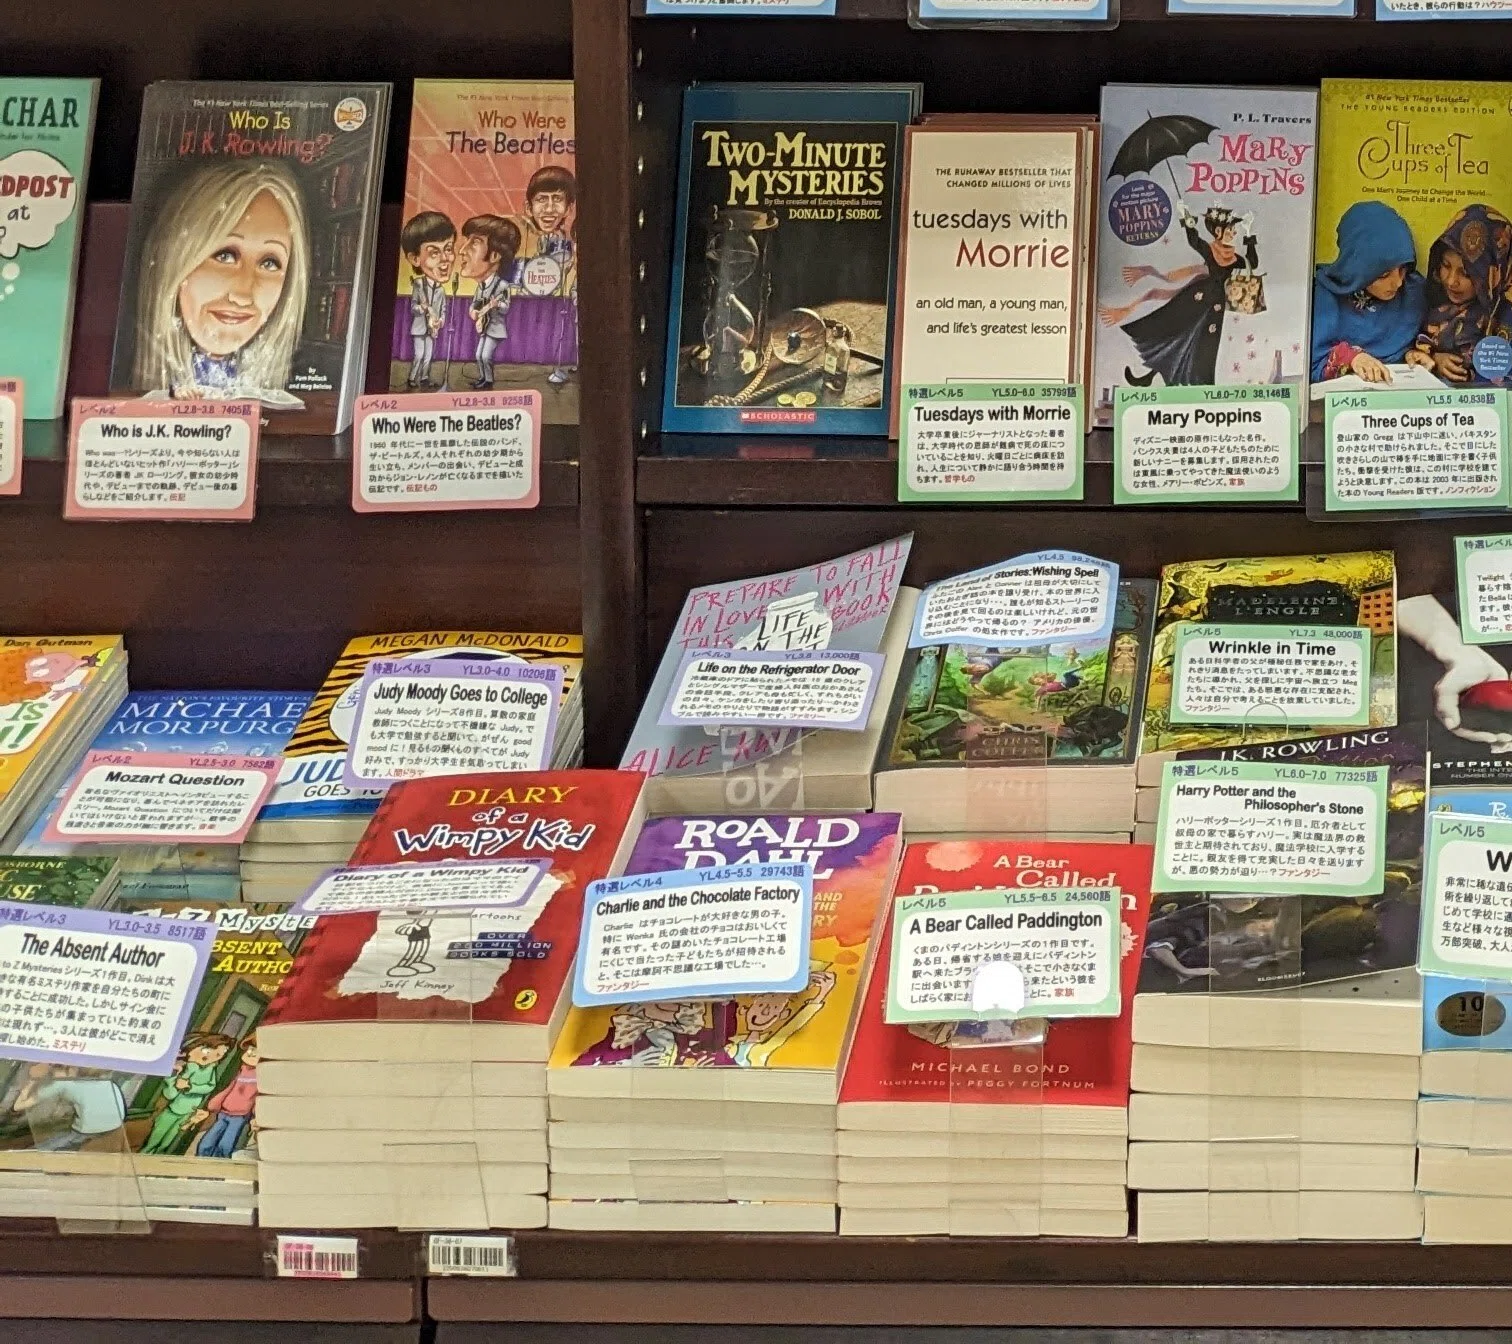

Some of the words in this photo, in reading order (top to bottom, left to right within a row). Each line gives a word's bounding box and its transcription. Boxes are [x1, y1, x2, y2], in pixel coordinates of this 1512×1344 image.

[913, 208, 1011, 232] tuesdays
[1019, 207, 1068, 230] with
[956, 238, 1070, 269] Morrie
[372, 416, 400, 434] Who
[403, 416, 436, 433] Were
[440, 415, 464, 432] The
[466, 413, 522, 431] Beatles?
[749, 412, 816, 422] SCHOLASTIC
[374, 682, 402, 702] Judy
[406, 684, 445, 703] Moody
[447, 685, 483, 703] Goes
[487, 687, 498, 702] to
[501, 688, 547, 708] College
[105, 772, 164, 786] Mozart
[167, 773, 245, 787] Question
[449, 786, 578, 806] DIARY
[395, 826, 522, 856] Wimpy
[522, 821, 594, 852] Kid
[597, 896, 637, 915] Charlie
[640, 895, 663, 912] and
[666, 894, 688, 910] the
[690, 888, 753, 908] Chocolate
[755, 885, 801, 903] Factory
